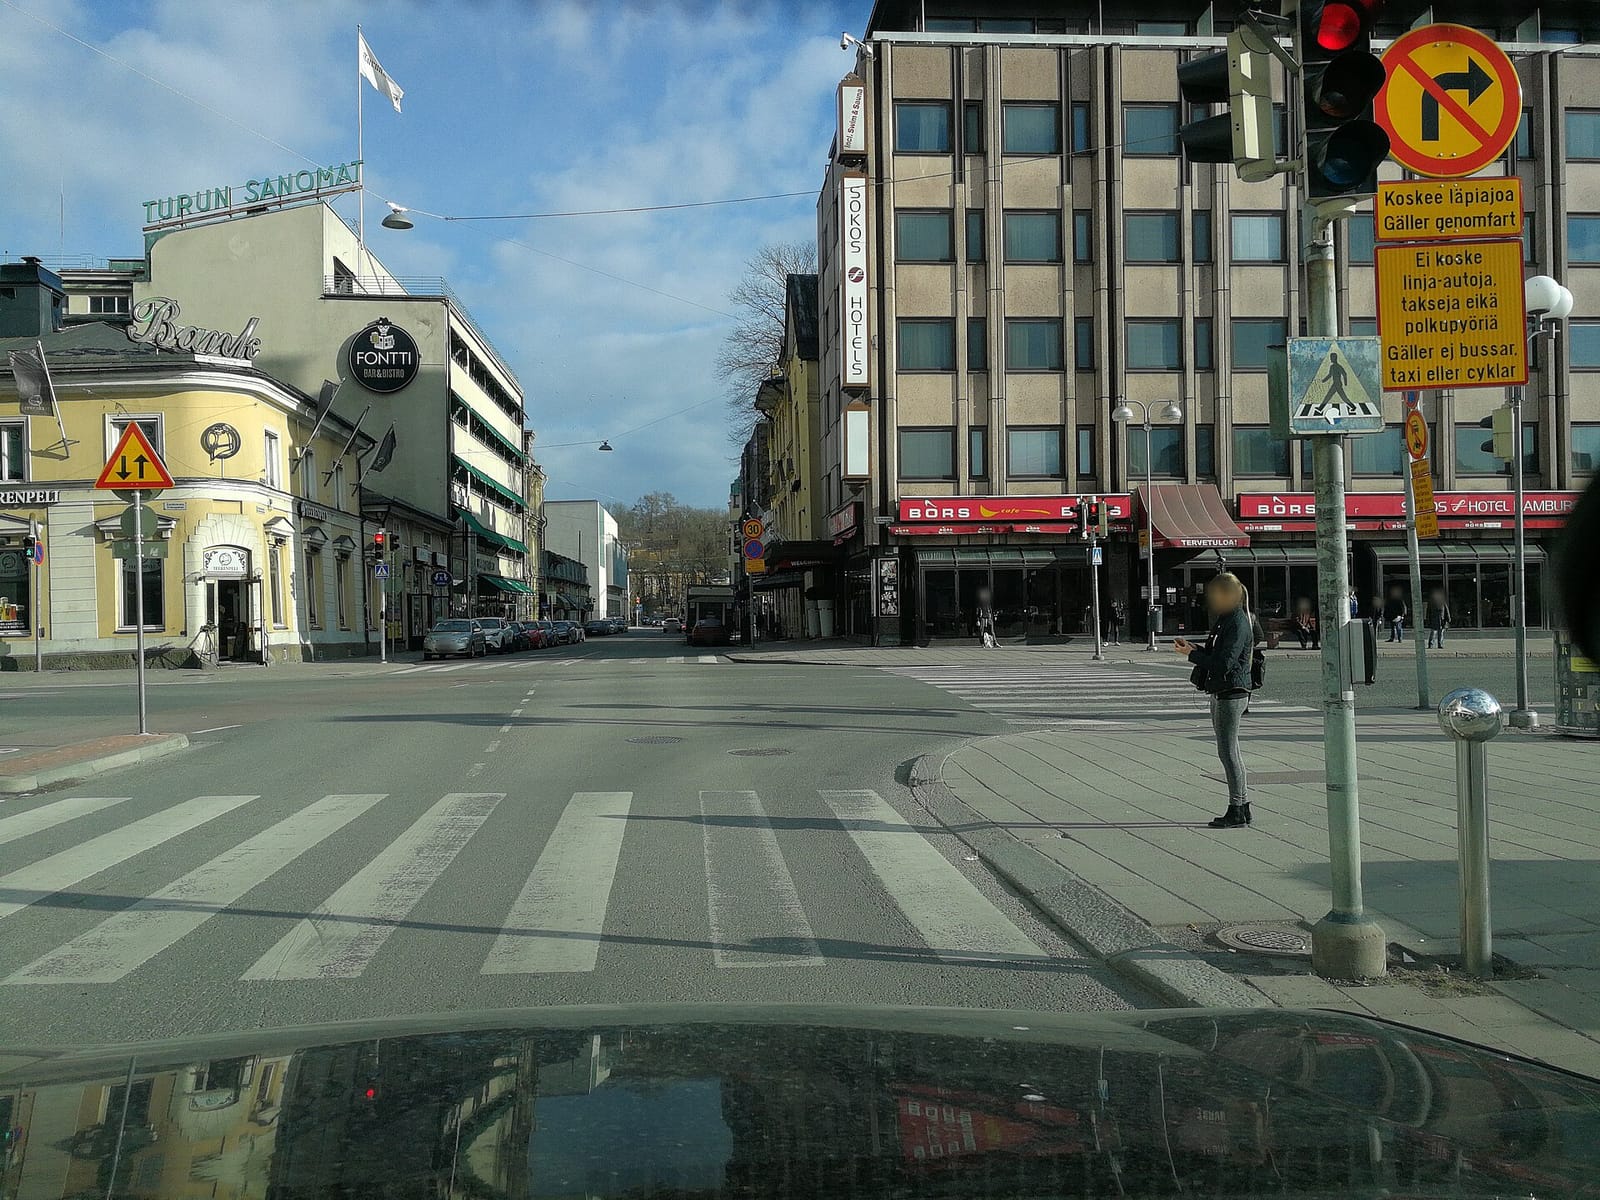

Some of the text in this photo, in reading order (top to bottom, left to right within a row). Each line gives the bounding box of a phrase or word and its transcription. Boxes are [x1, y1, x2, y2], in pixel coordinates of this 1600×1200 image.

[852, 88, 863, 110] Sauna
[847, 115, 858, 134] Swim
[142, 159, 364, 223] TURUN SANOMAT
[1384, 188, 1514, 208] Koskee läpiajoa
[849, 186, 862, 254] SOKOS
[1384, 211, 1516, 231] Gäller genomfart
[1416, 250, 1482, 268] Ei koske
[1403, 273, 1497, 292] linja-autoja,
[1401, 292, 1498, 312] takseja eikä
[126, 296, 263, 360] Bank
[850, 296, 863, 375] HOTELS
[1405, 316, 1498, 336] polkupyöriä
[356, 351, 411, 366] FONTTI
[1387, 344, 1434, 360] Gäller
[1440, 343, 1454, 360] ej
[1390, 364, 1516, 382] taxi eller cyklar
[1061, 506, 1121, 517] BS
[1468, 500, 1510, 512] HOTEL
[747, 524, 759, 535] 30
